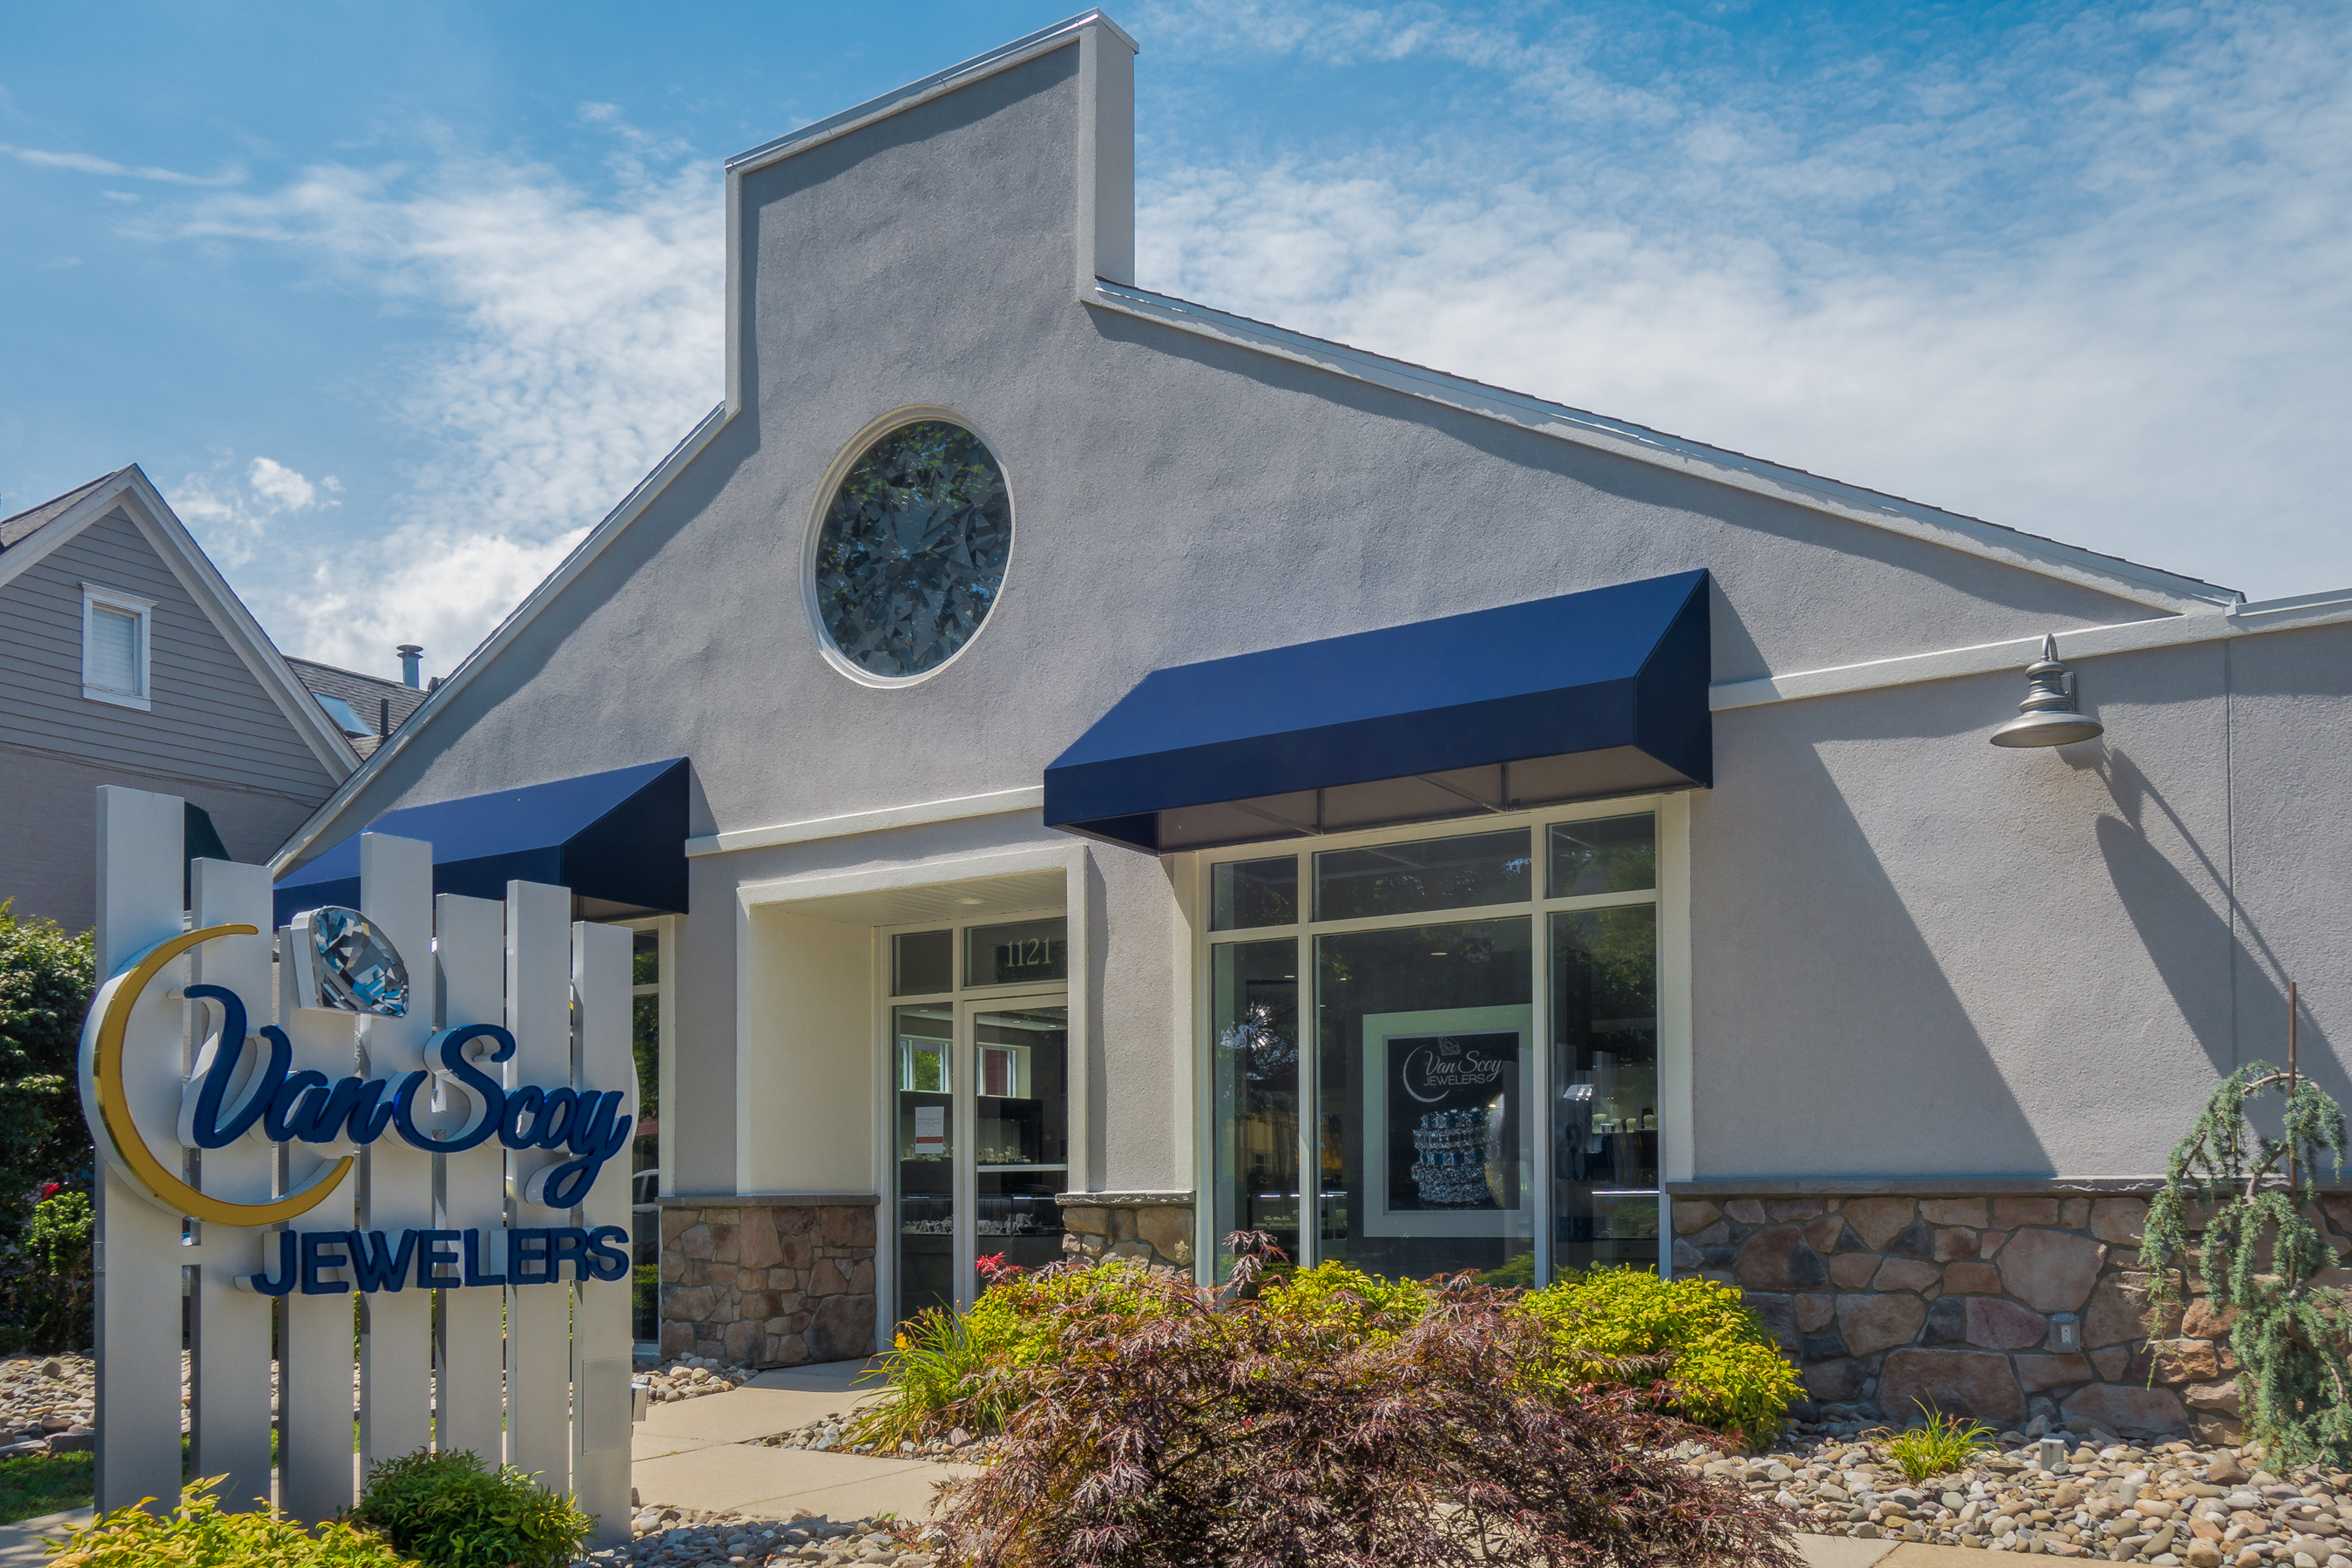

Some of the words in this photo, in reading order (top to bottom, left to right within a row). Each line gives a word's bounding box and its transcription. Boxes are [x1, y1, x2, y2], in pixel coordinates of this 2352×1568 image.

[1005, 936, 1052, 968] 1121
[1423, 1073, 1485, 1086] JEWELERS
[1424, 1050, 1457, 1076] Van
[1457, 1050, 1504, 1083] Scoy
[183, 983, 398, 1150] Van
[390, 1022, 632, 1209] Scoy
[250, 1224, 630, 1296] JEWELERS
